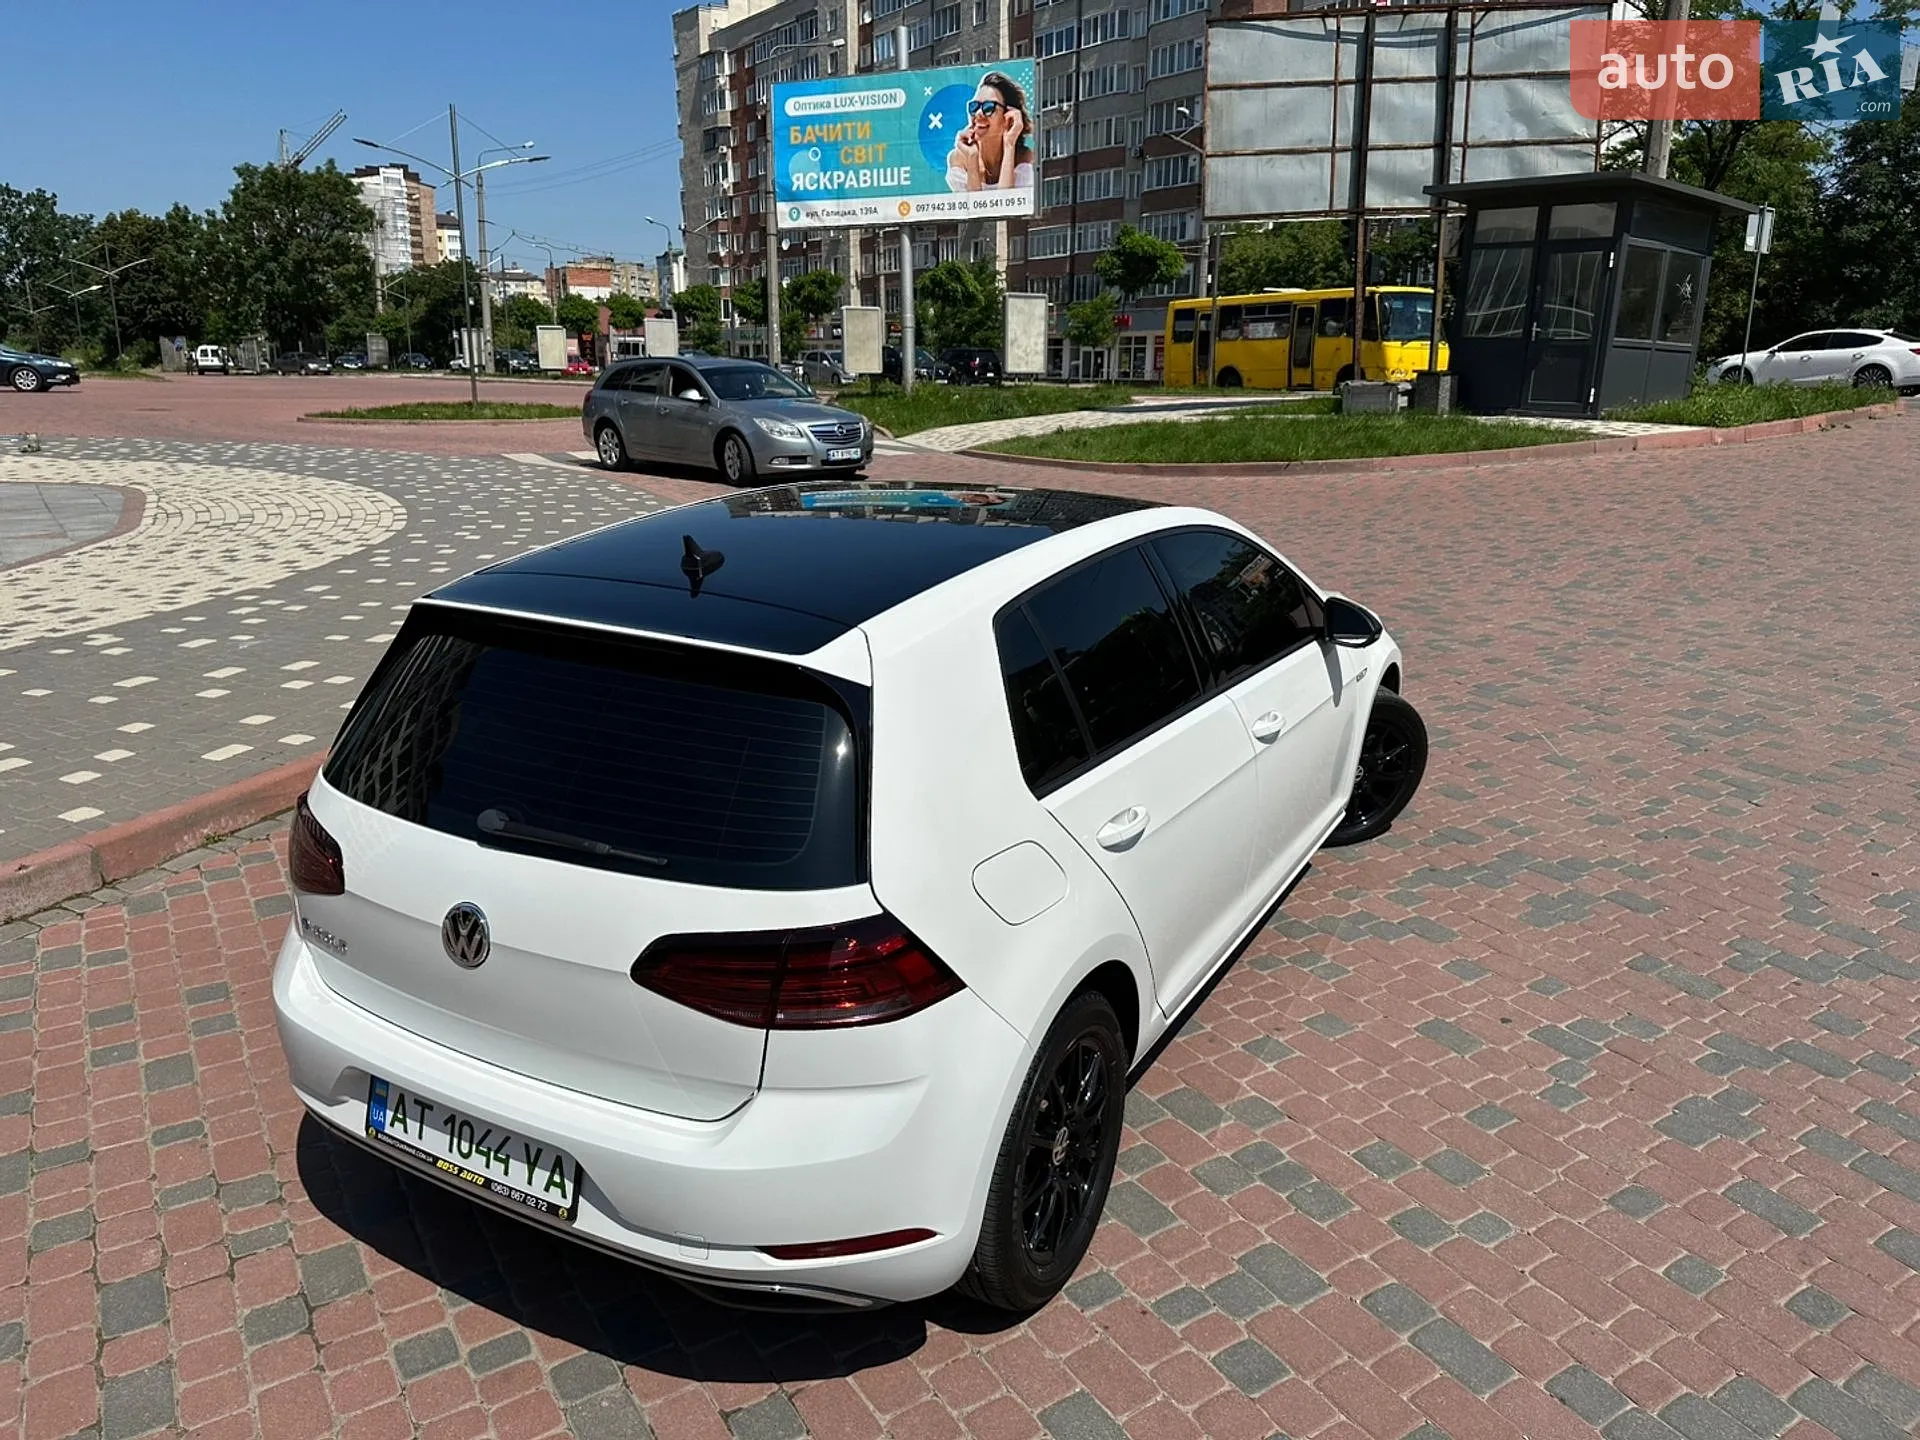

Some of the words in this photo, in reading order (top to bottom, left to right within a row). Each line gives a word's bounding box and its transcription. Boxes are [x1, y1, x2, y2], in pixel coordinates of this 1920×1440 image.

[793, 99, 832, 112] Оптика
[833, 92, 898, 109] LUX-VISION
[789, 120, 872, 145] БАЧИТИ
[841, 143, 887, 165] СВІТ
[791, 165, 912, 192] ЯСКРАВІШЕ
[930, 202, 945, 212] 942
[372, 1107, 385, 1124] UA
[389, 1092, 434, 1141] AT
[443, 1113, 512, 1177] 1044
[523, 1142, 568, 1200] YA
[436, 1159, 460, 1176] BOSS
